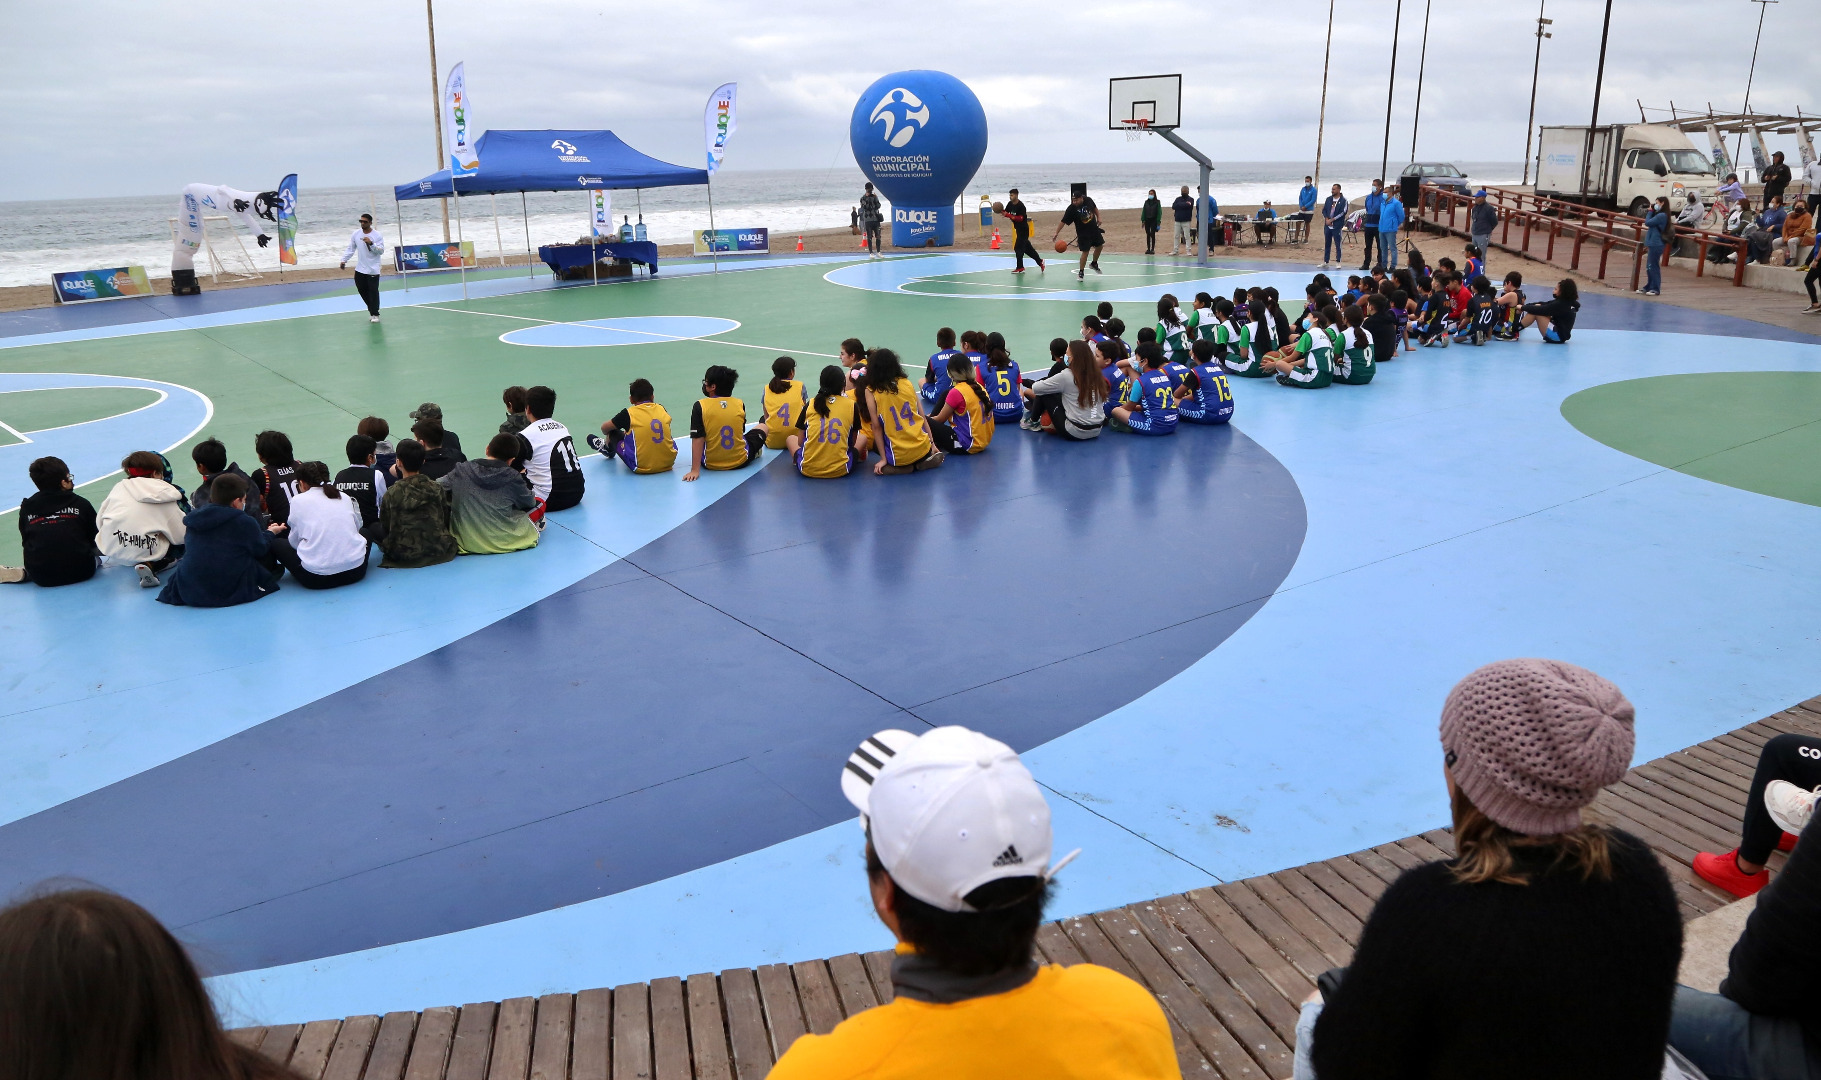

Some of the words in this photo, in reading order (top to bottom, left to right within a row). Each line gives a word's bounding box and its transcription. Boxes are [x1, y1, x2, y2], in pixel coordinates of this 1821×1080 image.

[453, 91, 465, 147] IQUIQUE
[714, 101, 731, 147] IQUIQUE
[871, 154, 930, 163] CORPORACIÓN
[872, 163, 932, 172] MUNICIPAL
[595, 189, 606, 224] IQUIQU
[895, 209, 938, 225] IQUIQUE
[738, 233, 764, 242] IQUIQUE
[401, 252, 428, 261] QUIQUE
[62, 279, 96, 290] IQUIQUE
[1478, 308, 1493, 325] 10
[1180, 332, 1190, 350] 8
[996, 370, 1011, 397] 5
[1212, 375, 1232, 402] 13
[776, 402, 790, 427] 4
[889, 401, 916, 432] 14
[650, 418, 664, 444] 9
[720, 425, 735, 450] 8
[818, 417, 843, 444] 16
[556, 440, 581, 473] 11
[277, 466, 295, 476] ELÍAS
[113, 529, 129, 548] THE
